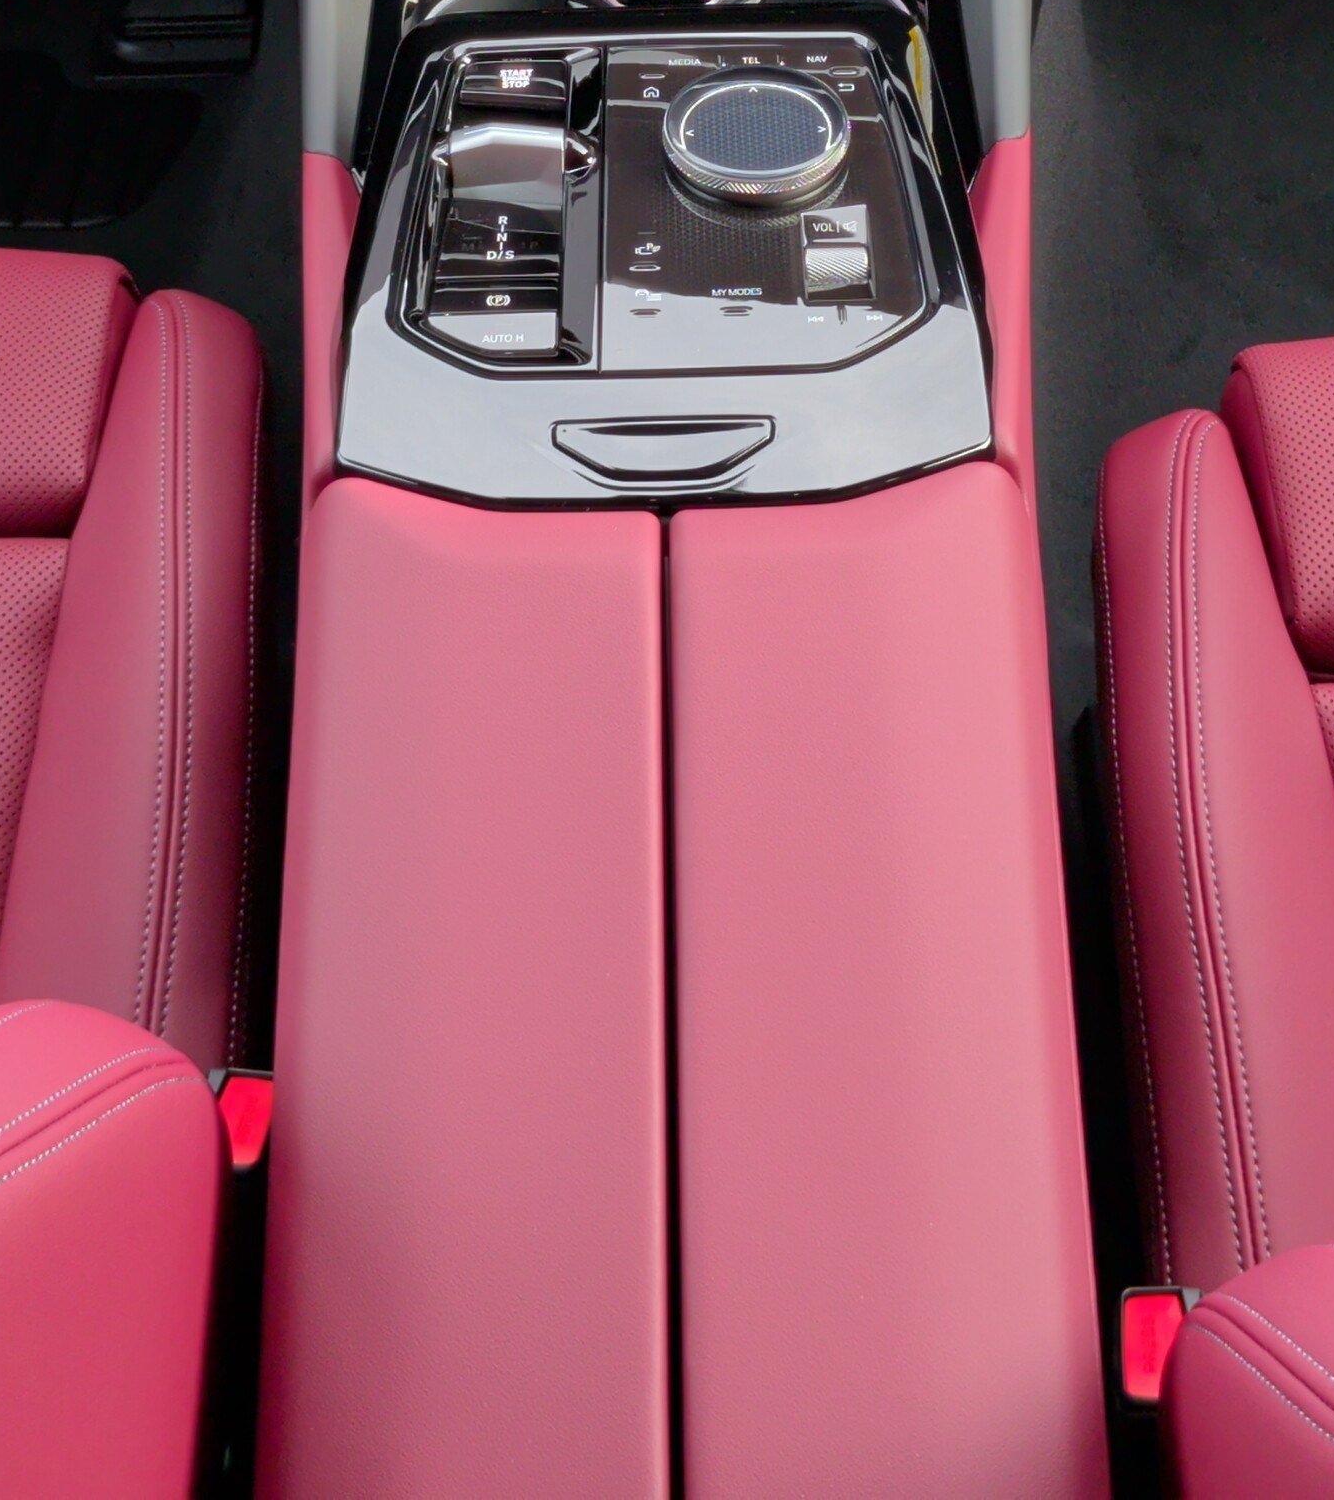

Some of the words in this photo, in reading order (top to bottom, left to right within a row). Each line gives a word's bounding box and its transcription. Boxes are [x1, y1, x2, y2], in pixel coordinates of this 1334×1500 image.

[668, 58, 701, 66] MEDIA
[742, 56, 761, 64] TEL
[806, 55, 827, 63] NAV
[500, 69, 533, 77] START
[498, 216, 508, 224] R
[812, 223, 834, 232] VOL
[497, 233, 507, 241] N
[487, 250, 515, 260] D/S
[728, 287, 763, 296] MODES
[482, 334, 512, 343] AUTO
[516, 334, 524, 342] H
